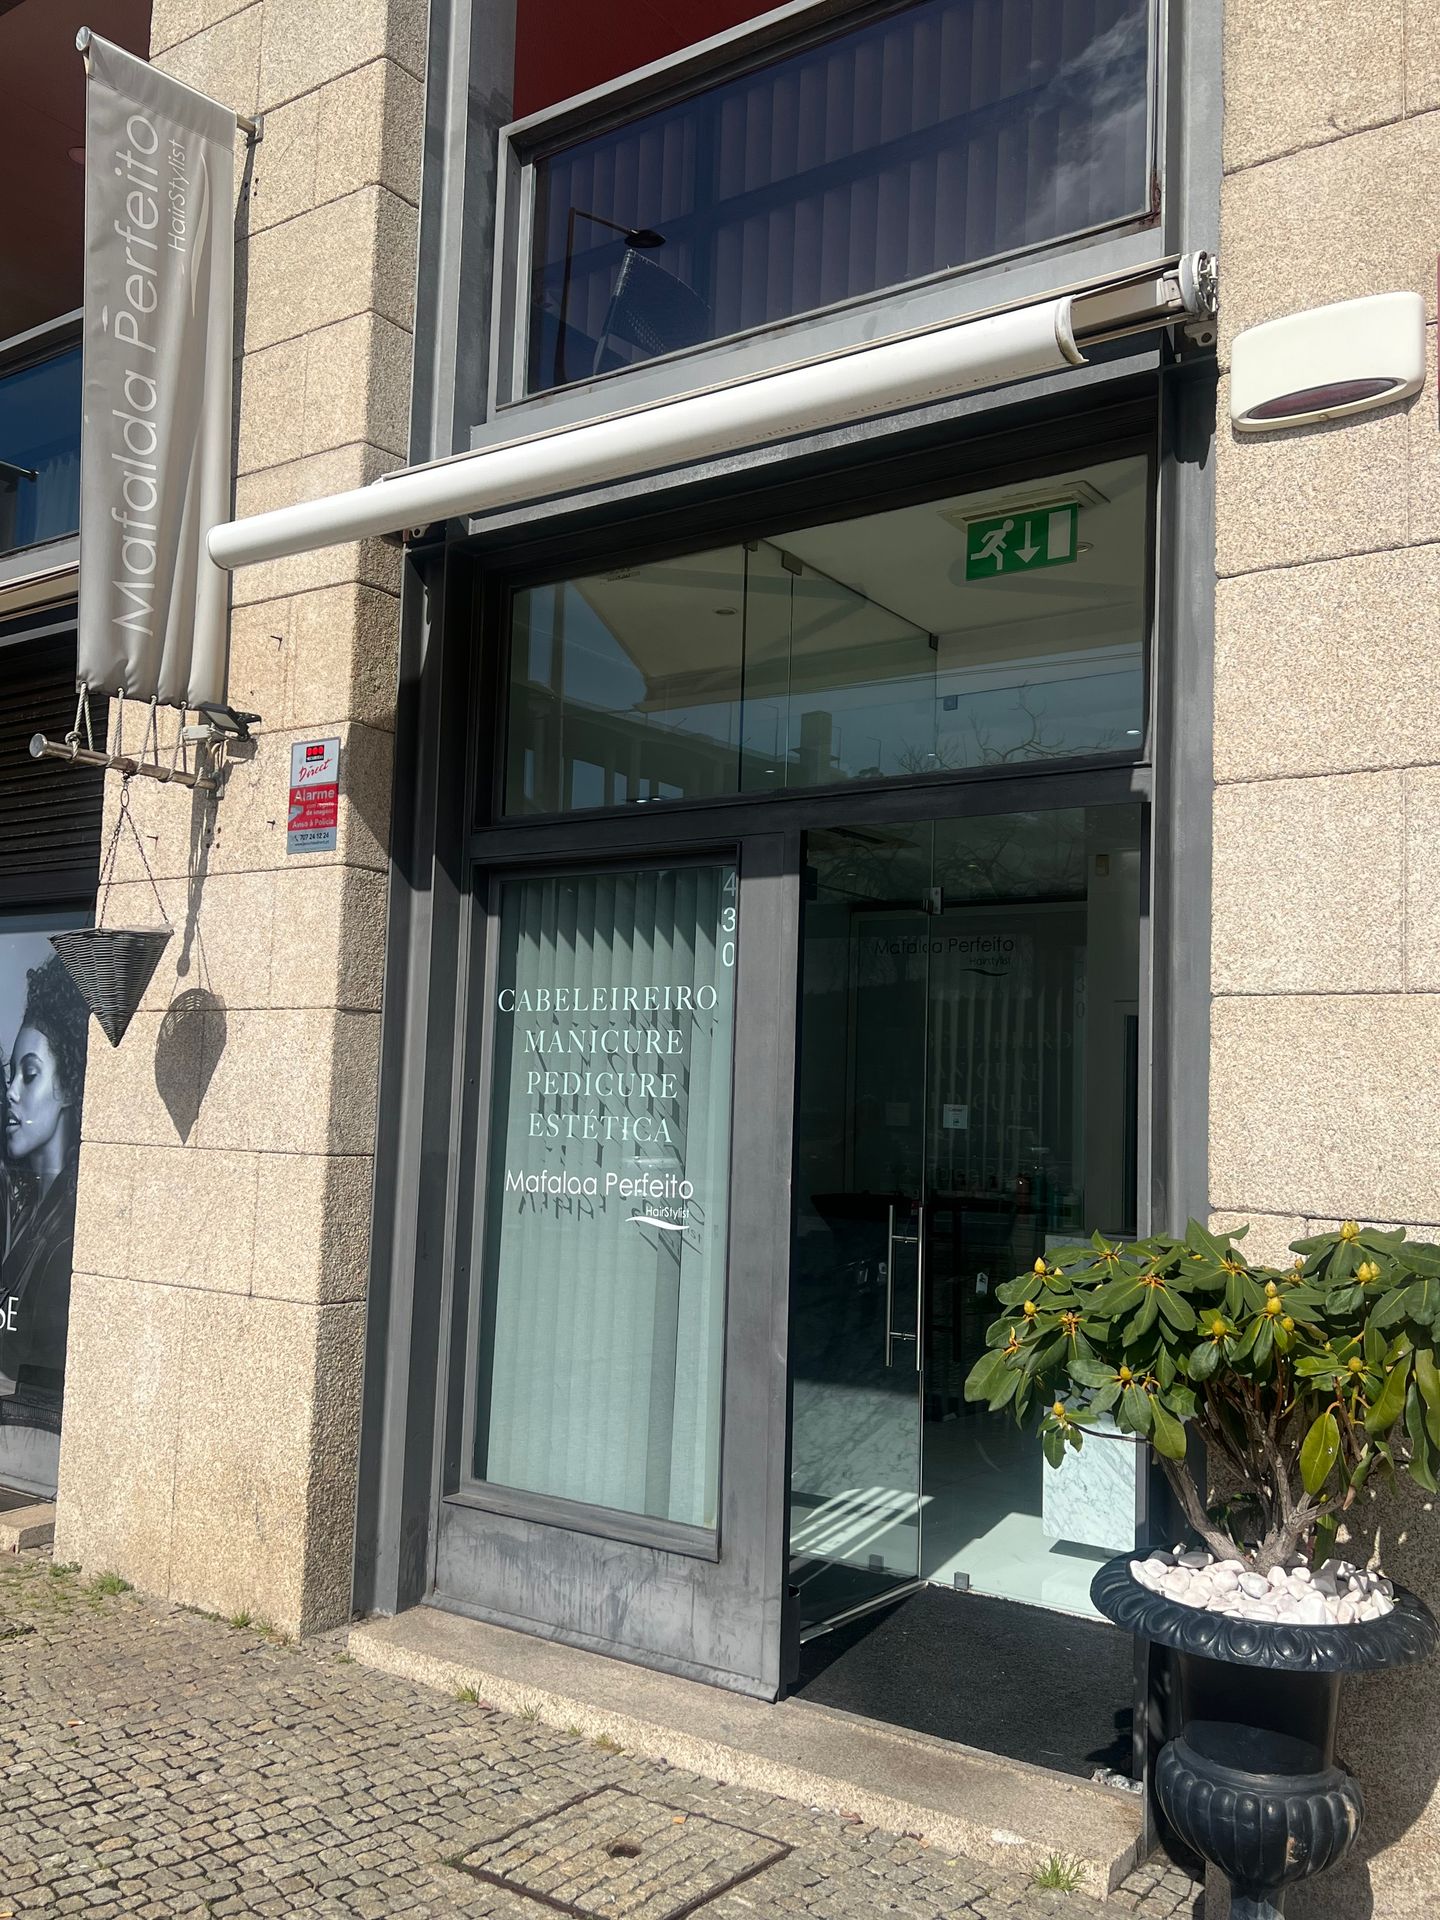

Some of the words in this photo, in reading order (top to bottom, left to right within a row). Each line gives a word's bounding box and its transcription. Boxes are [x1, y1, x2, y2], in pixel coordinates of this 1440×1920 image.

[167, 138, 190, 252] HairStylist
[114, 115, 159, 353] Perfeito
[111, 369, 158, 636] Mafalda
[294, 789, 335, 803] Alarme
[722, 871, 736, 967] 430
[498, 985, 718, 1012] CABELEIREIRO
[524, 1029, 684, 1054] MANICURE
[526, 1071, 678, 1099] PEDICURE
[528, 1109, 673, 1143] ESTÉTICA
[605, 1172, 694, 1200] Perfeito
